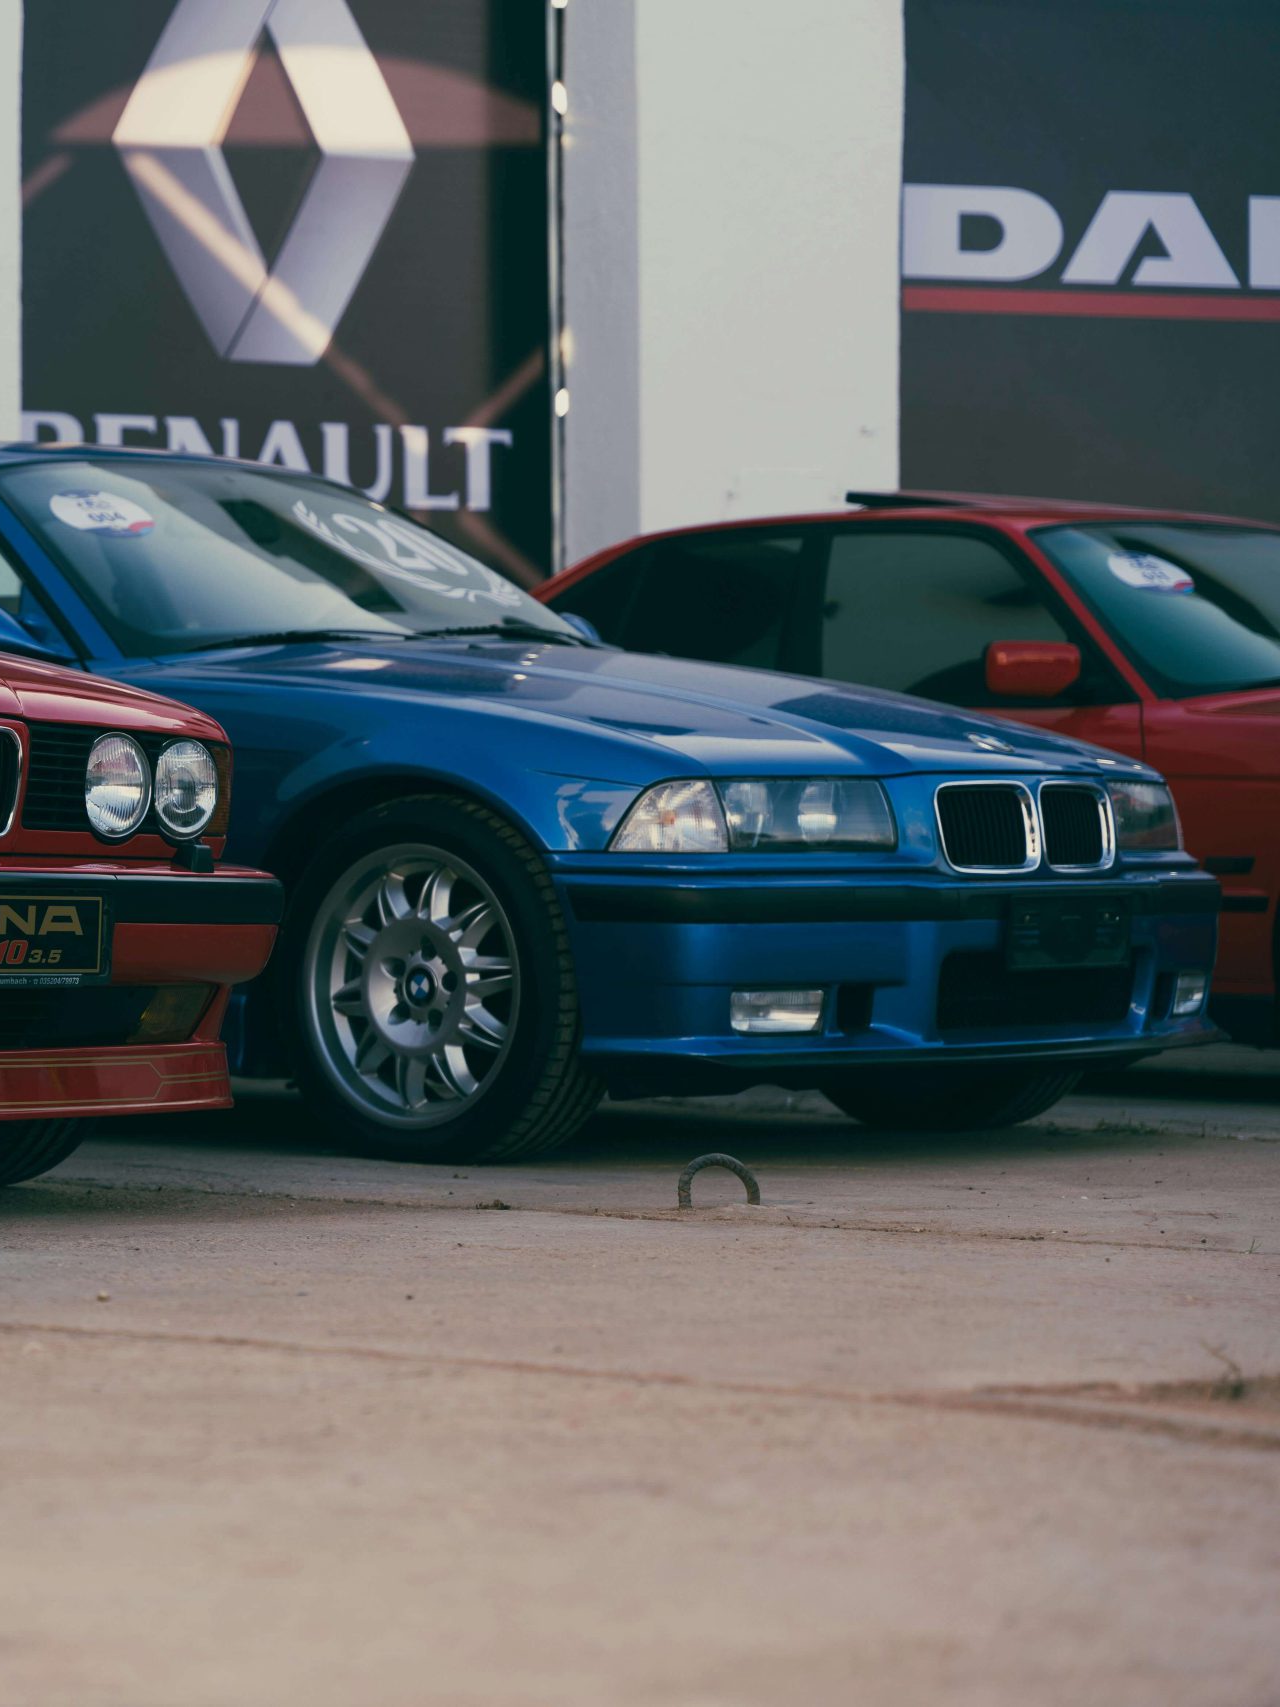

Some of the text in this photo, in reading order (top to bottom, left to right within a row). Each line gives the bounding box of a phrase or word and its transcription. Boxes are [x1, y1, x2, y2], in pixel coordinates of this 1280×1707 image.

[903, 183, 1280, 290] DA
[332, 512, 469, 577] 20
[28, 949, 63, 965] 3.5
